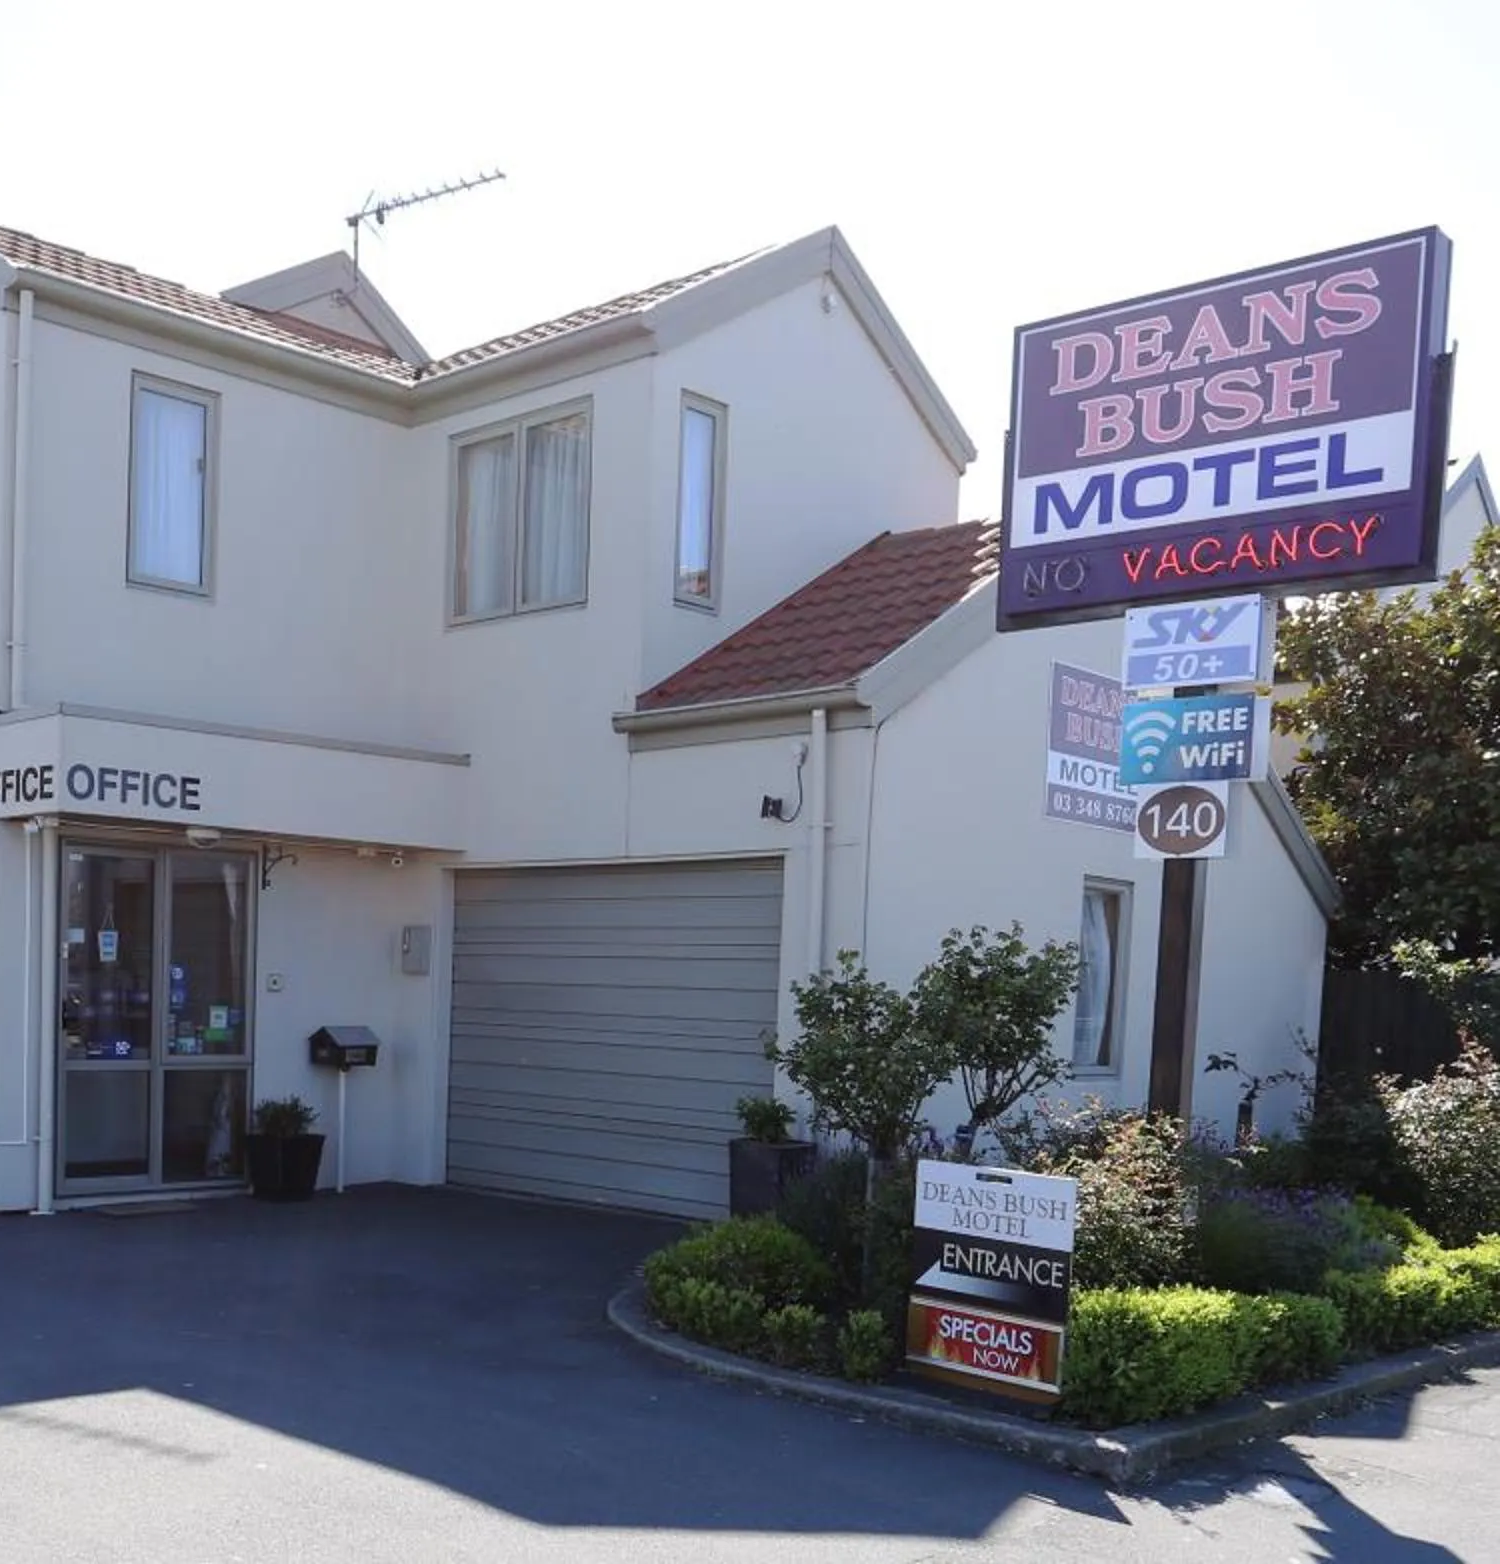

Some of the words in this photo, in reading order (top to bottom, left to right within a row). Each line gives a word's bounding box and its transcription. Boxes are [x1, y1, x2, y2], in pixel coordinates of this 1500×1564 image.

[1049, 267, 1382, 396] DEANS
[1075, 349, 1343, 459] BUSH
[1033, 432, 1384, 535] MOTEL
[1023, 557, 1086, 593] NO
[1123, 516, 1380, 583] VACANCY
[1153, 653, 1223, 680] 50+
[1181, 707, 1249, 735] FREE
[1179, 741, 1245, 769] WiFi
[66, 763, 201, 811] OFFICE
[1053, 792, 1071, 812] 03
[1076, 798, 1101, 818] 348
[1146, 801, 1217, 840] 140
[922, 1181, 997, 1213] DEANS
[1005, 1193, 1068, 1222] BUSH
[951, 1208, 1030, 1239] MOTEL
[942, 1244, 1064, 1288] ENTRANCE
[939, 1313, 1033, 1356] SPECIALS
[972, 1348, 1021, 1373] NOW
